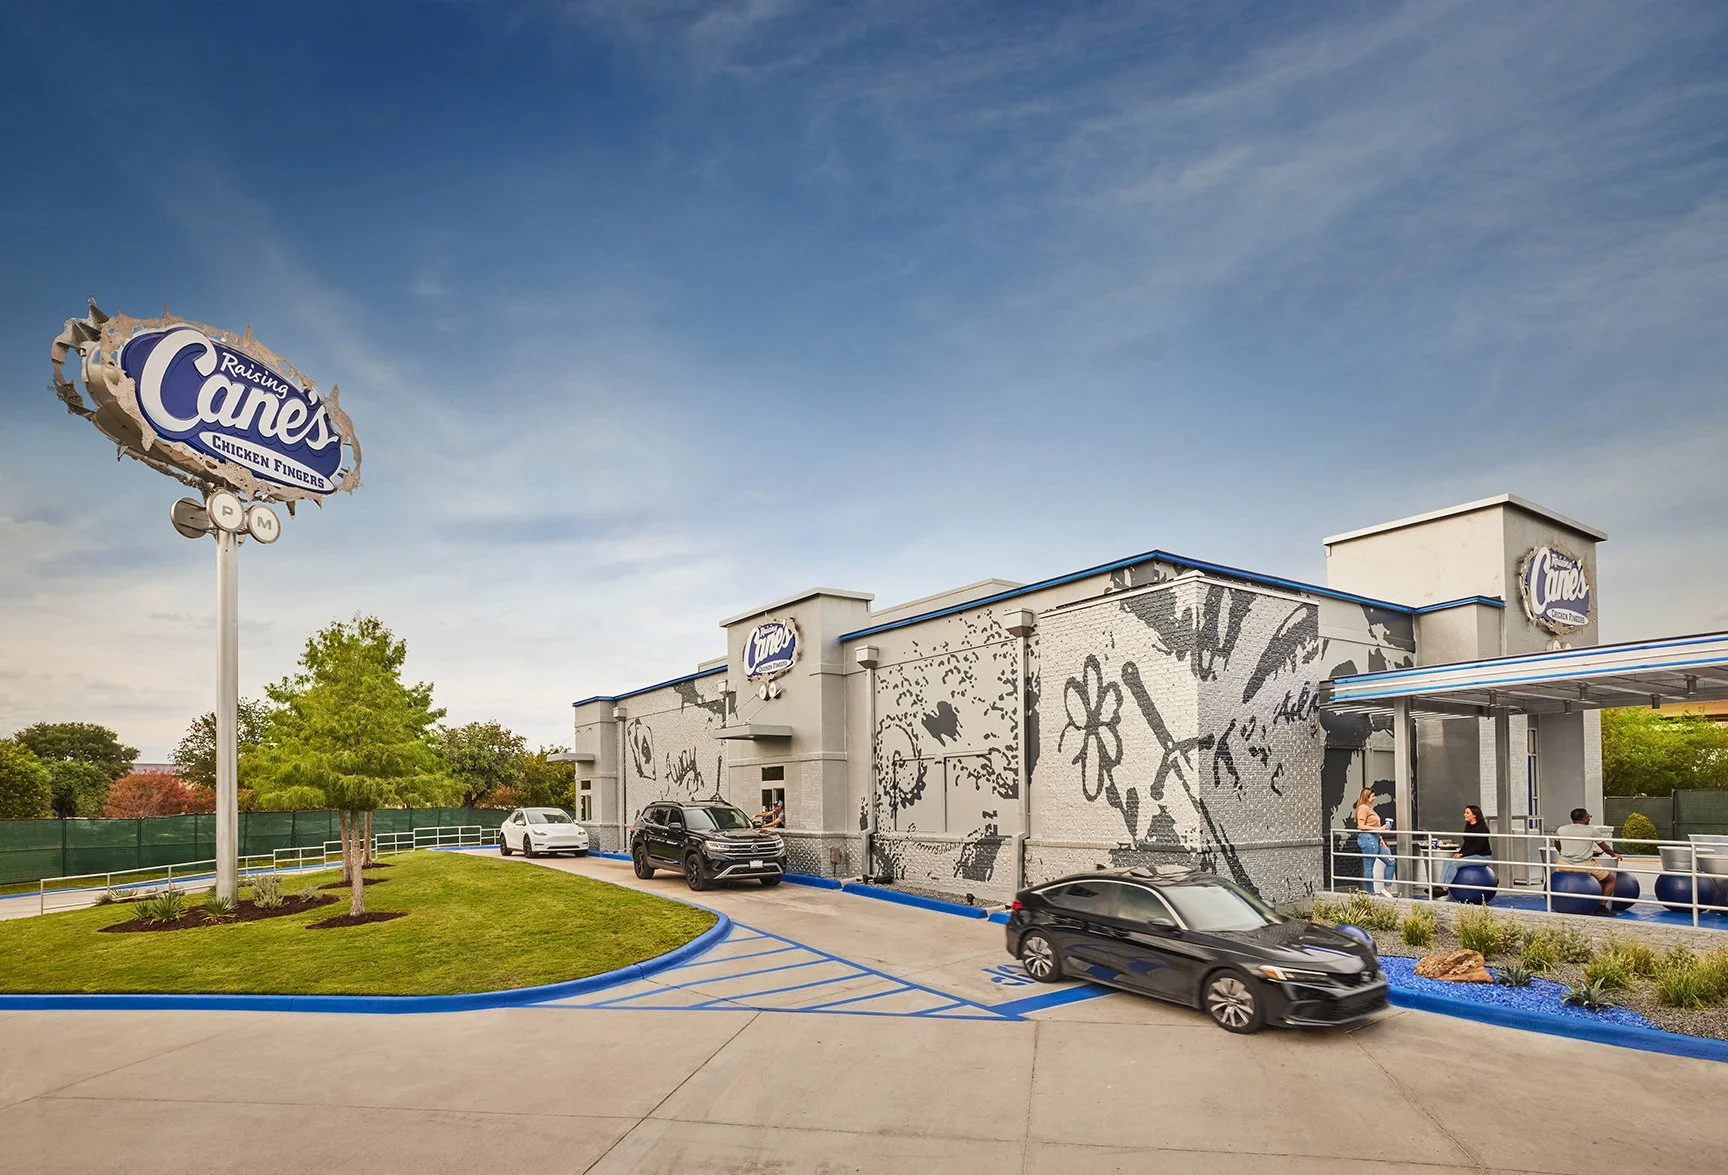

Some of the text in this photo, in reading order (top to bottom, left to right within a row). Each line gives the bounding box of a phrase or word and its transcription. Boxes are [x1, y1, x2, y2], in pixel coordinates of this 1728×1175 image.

[140, 329, 340, 450] Cane's
[220, 352, 288, 398] Raising
[222, 505, 234, 517] P
[257, 516, 272, 531] M
[1530, 546, 1589, 615] Cane's
[744, 619, 794, 676] Cane's
